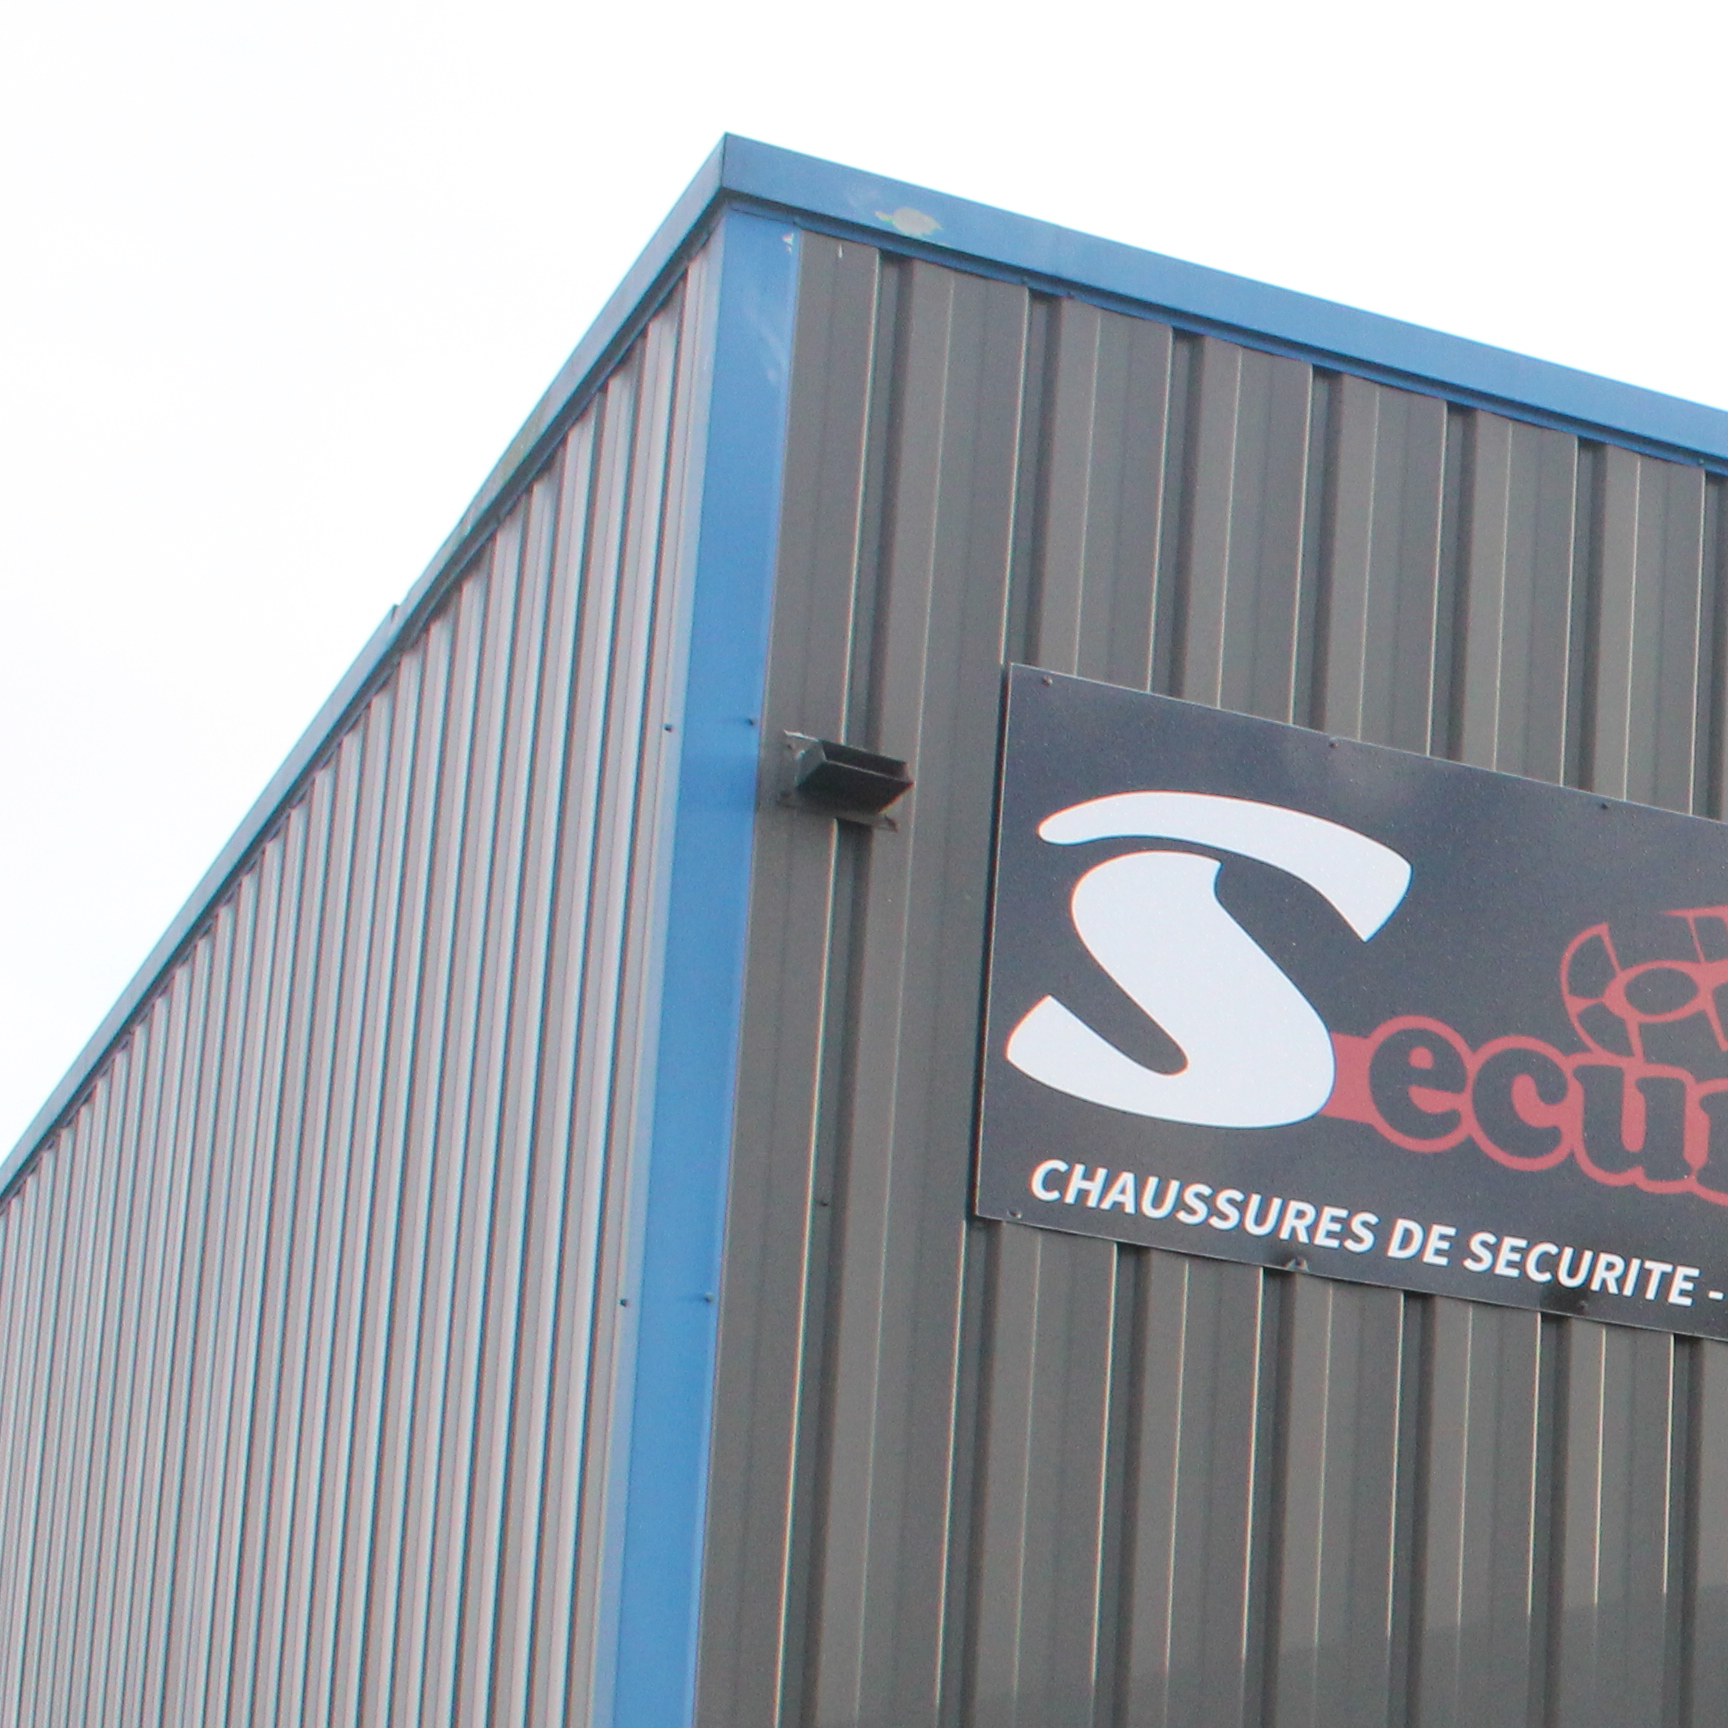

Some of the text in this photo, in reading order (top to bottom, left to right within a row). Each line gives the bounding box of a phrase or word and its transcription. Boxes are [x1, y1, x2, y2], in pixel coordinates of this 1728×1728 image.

[1030, 1158, 1380, 1254] CHAUSSURES
[1387, 1218, 1457, 1267] DE
[1463, 1231, 1700, 1308] SECURITE
